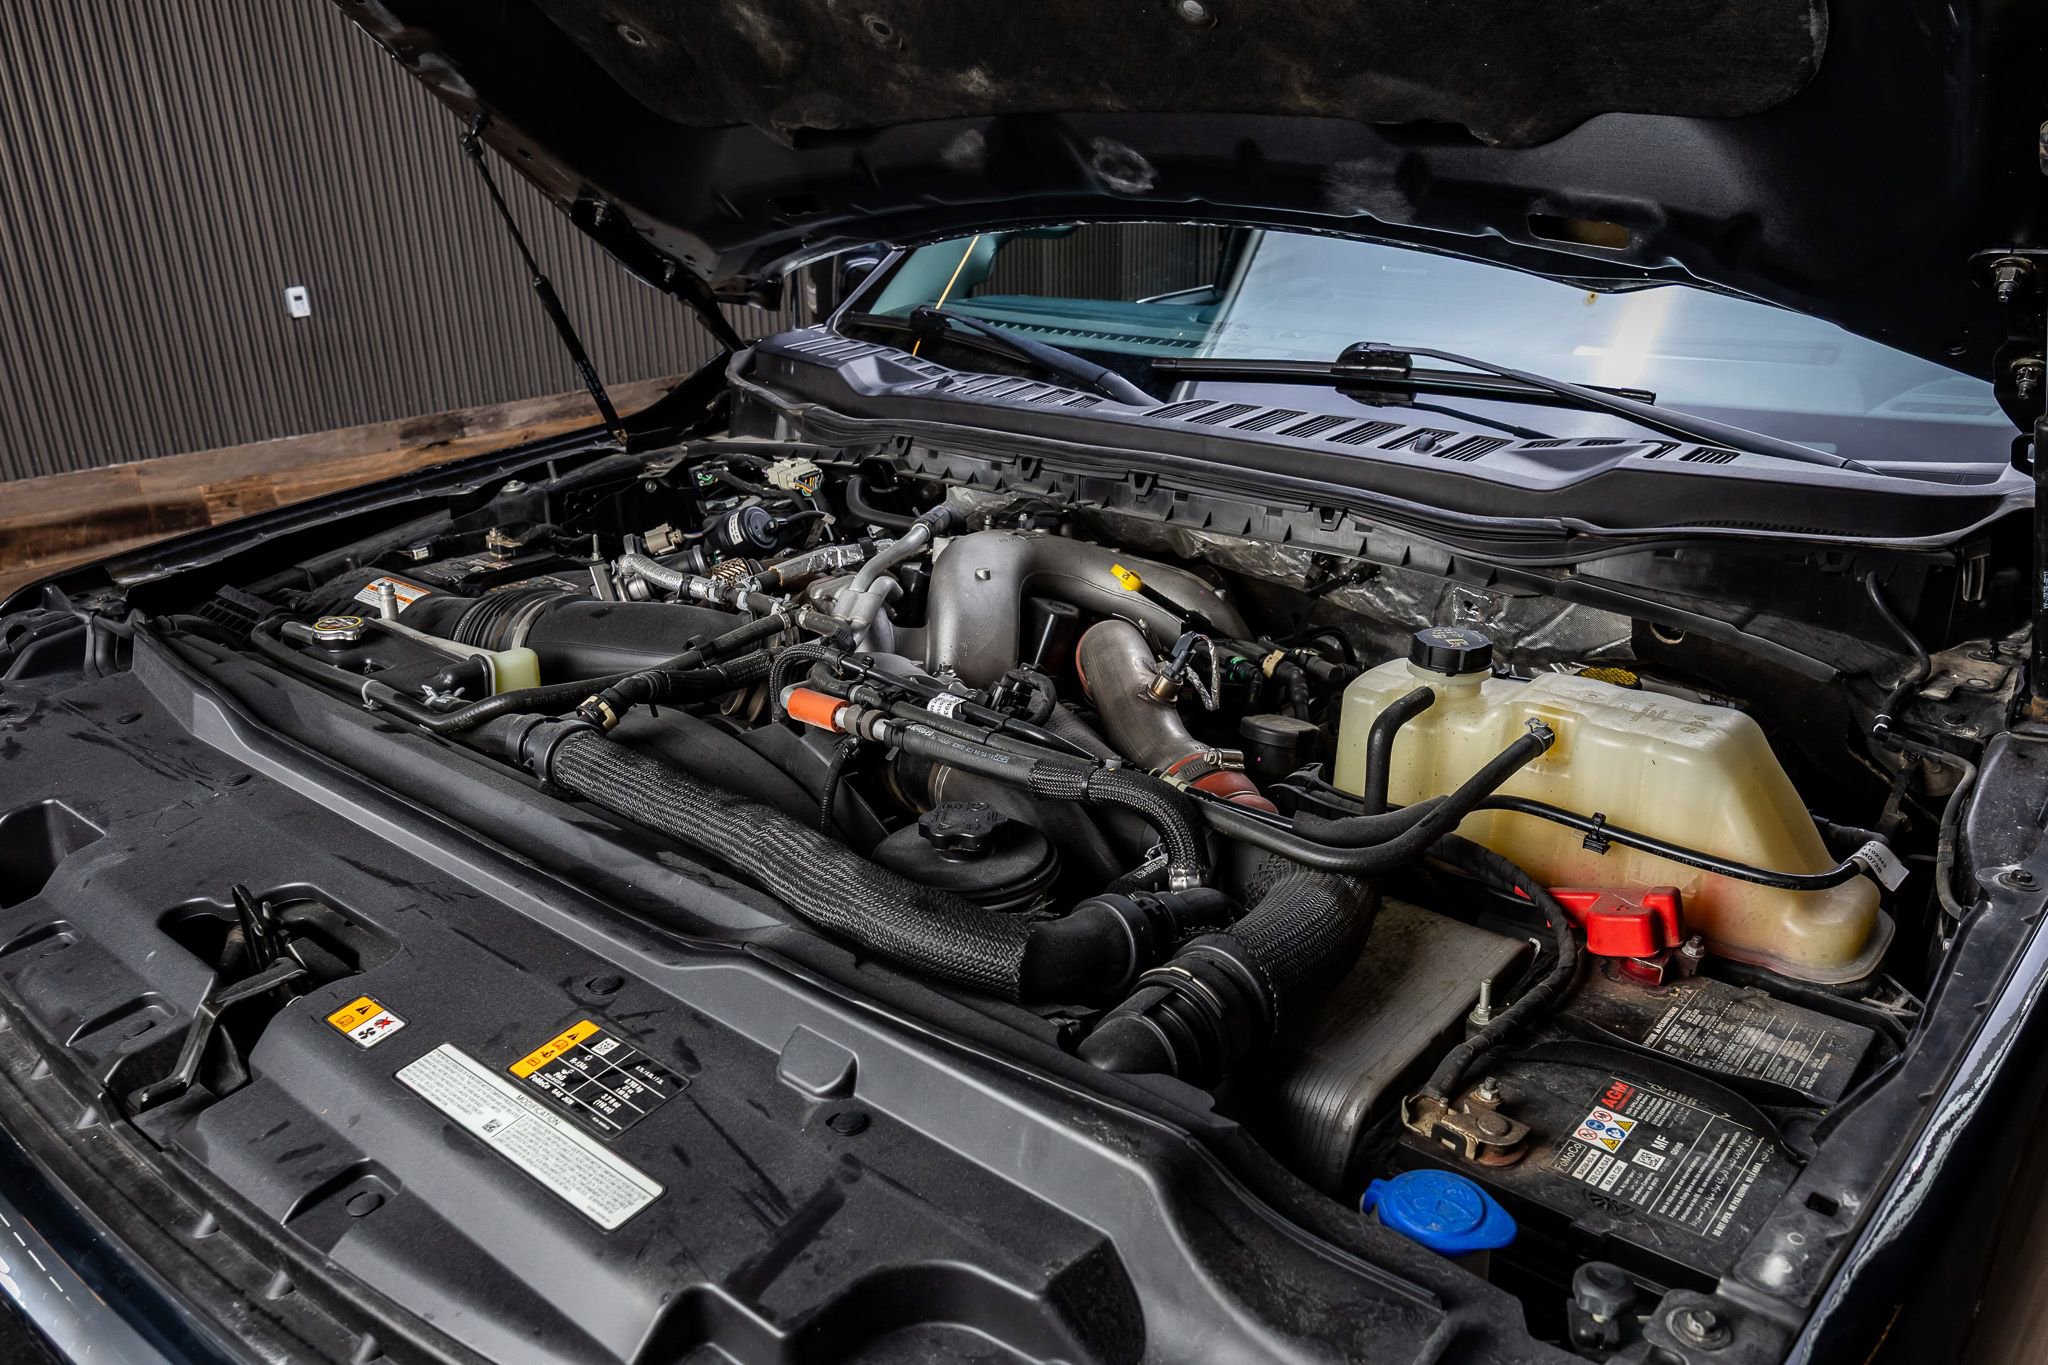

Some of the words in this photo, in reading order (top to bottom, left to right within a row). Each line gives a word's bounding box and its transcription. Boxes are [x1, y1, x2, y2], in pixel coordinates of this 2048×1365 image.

[568, 1056, 590, 1070] R-134a
[527, 1073, 552, 1090] FoMoCo
[1599, 1079, 1629, 1109] AGM
[514, 1094, 562, 1126] MODIFICATION
[1650, 1133, 1671, 1151] MF
[1553, 1140, 1582, 1172] FoMoCo
